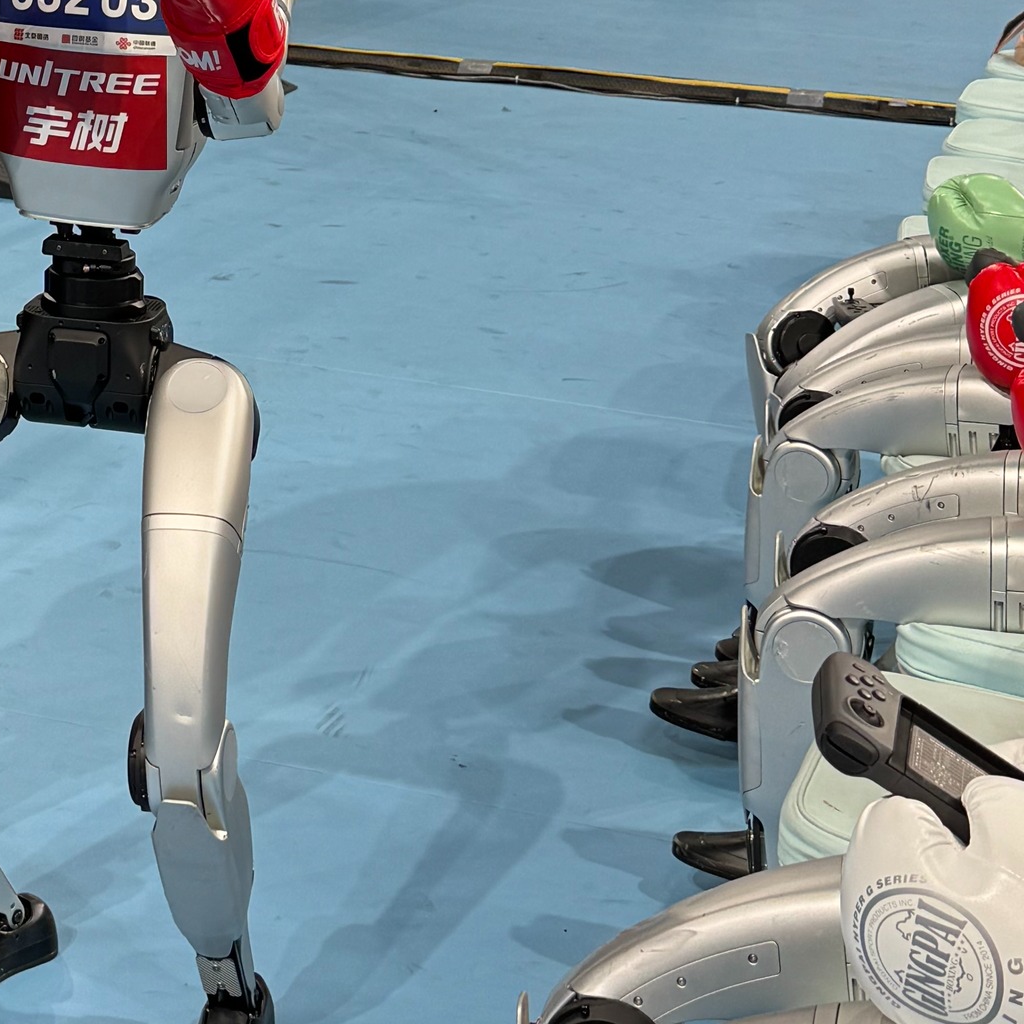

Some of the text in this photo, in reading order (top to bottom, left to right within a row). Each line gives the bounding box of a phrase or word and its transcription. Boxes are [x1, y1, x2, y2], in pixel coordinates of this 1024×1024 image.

[23, 105, 129, 154] 宇树
[992, 287, 1022, 306] SERIES
[983, 343, 1014, 372] GINGPAI
[869, 900, 898, 927] PRODUCTS
[898, 898, 913, 907] INC
[853, 874, 928, 1009] GINGPAI HYPER G SERIES
[976, 940, 990, 960] 2014
[902, 898, 968, 1017] GINGPAI
[946, 957, 959, 992] BOXING
[984, 962, 994, 992] SINCE
[978, 989, 993, 1013] CHINA
